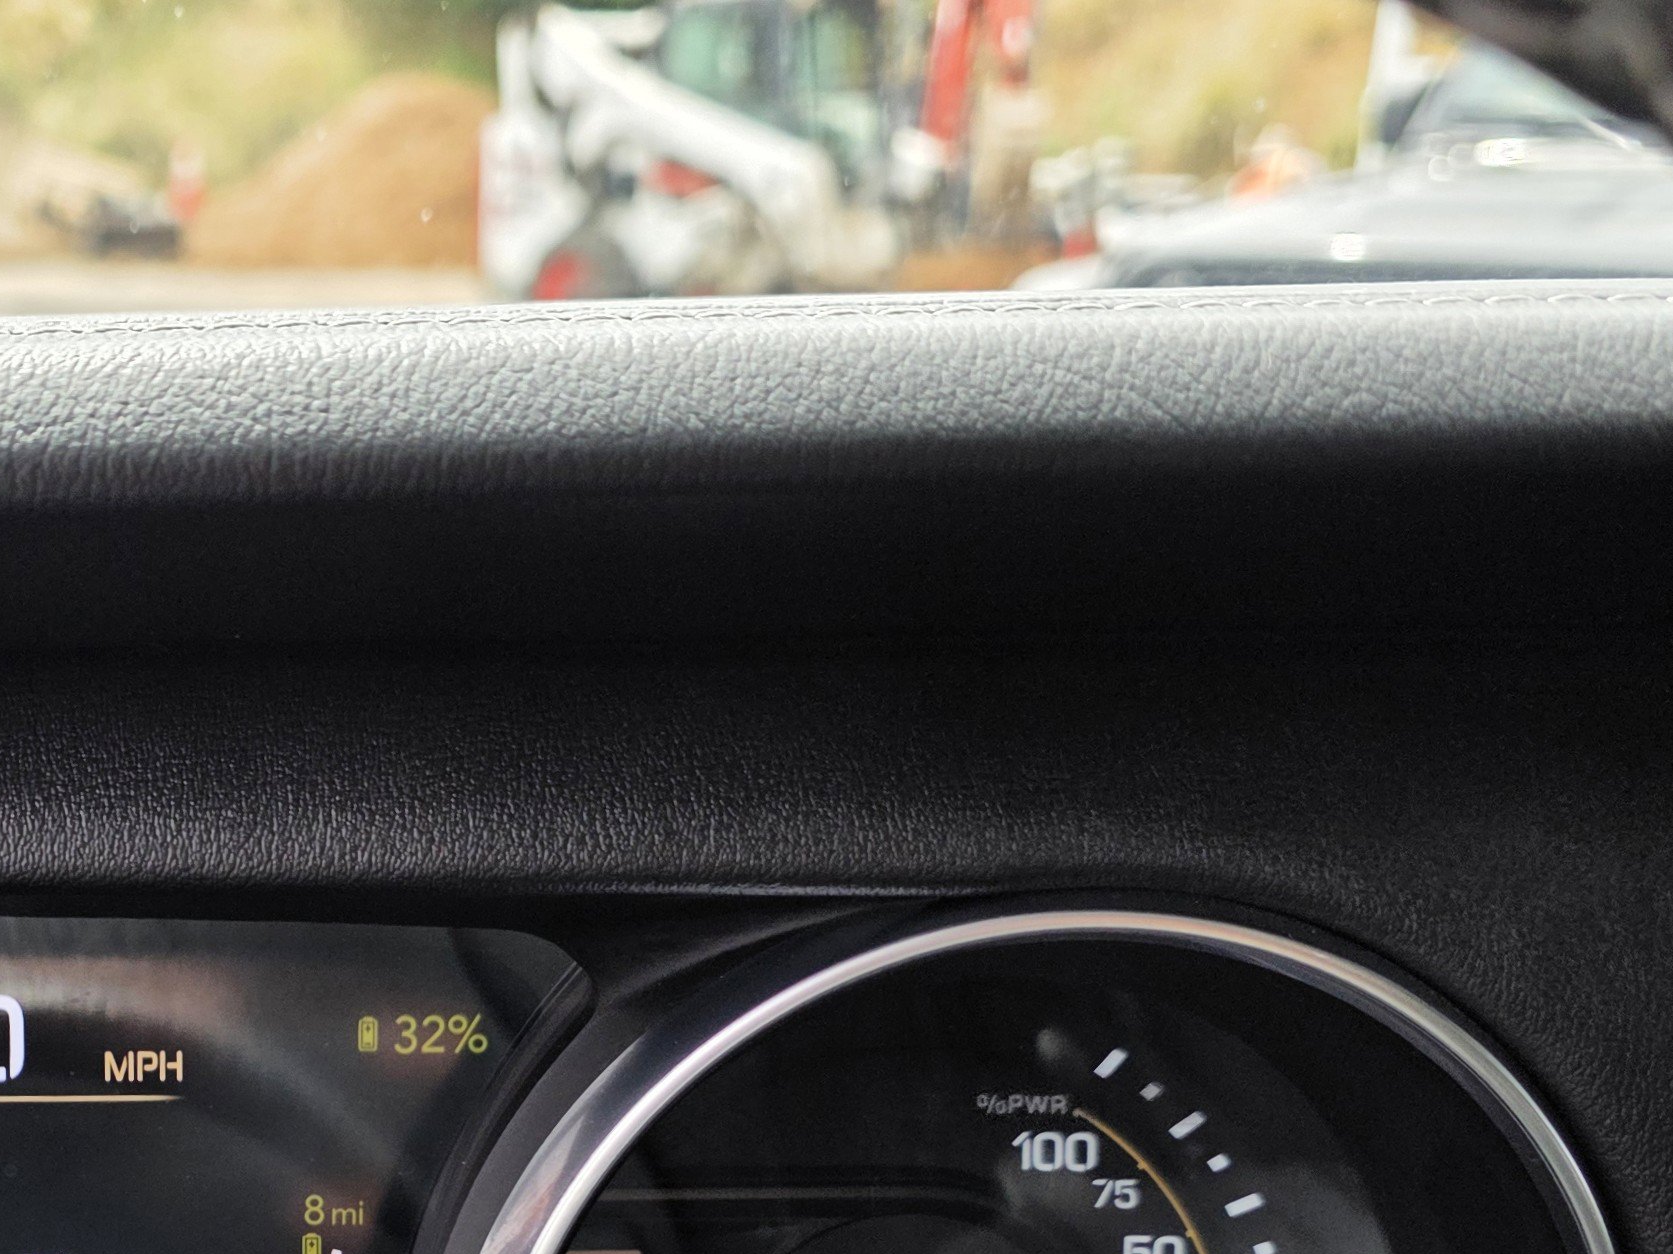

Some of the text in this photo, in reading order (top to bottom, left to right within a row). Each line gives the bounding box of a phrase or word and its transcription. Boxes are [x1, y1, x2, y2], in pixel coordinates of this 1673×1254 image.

[393, 1014, 488, 1056] 32%
[104, 1049, 184, 1082] MPH
[976, 1094, 1069, 1115] %PWR
[1011, 1130, 1102, 1173] 100
[304, 1194, 364, 1226] 8 mi
[1091, 1178, 1140, 1210] 75
